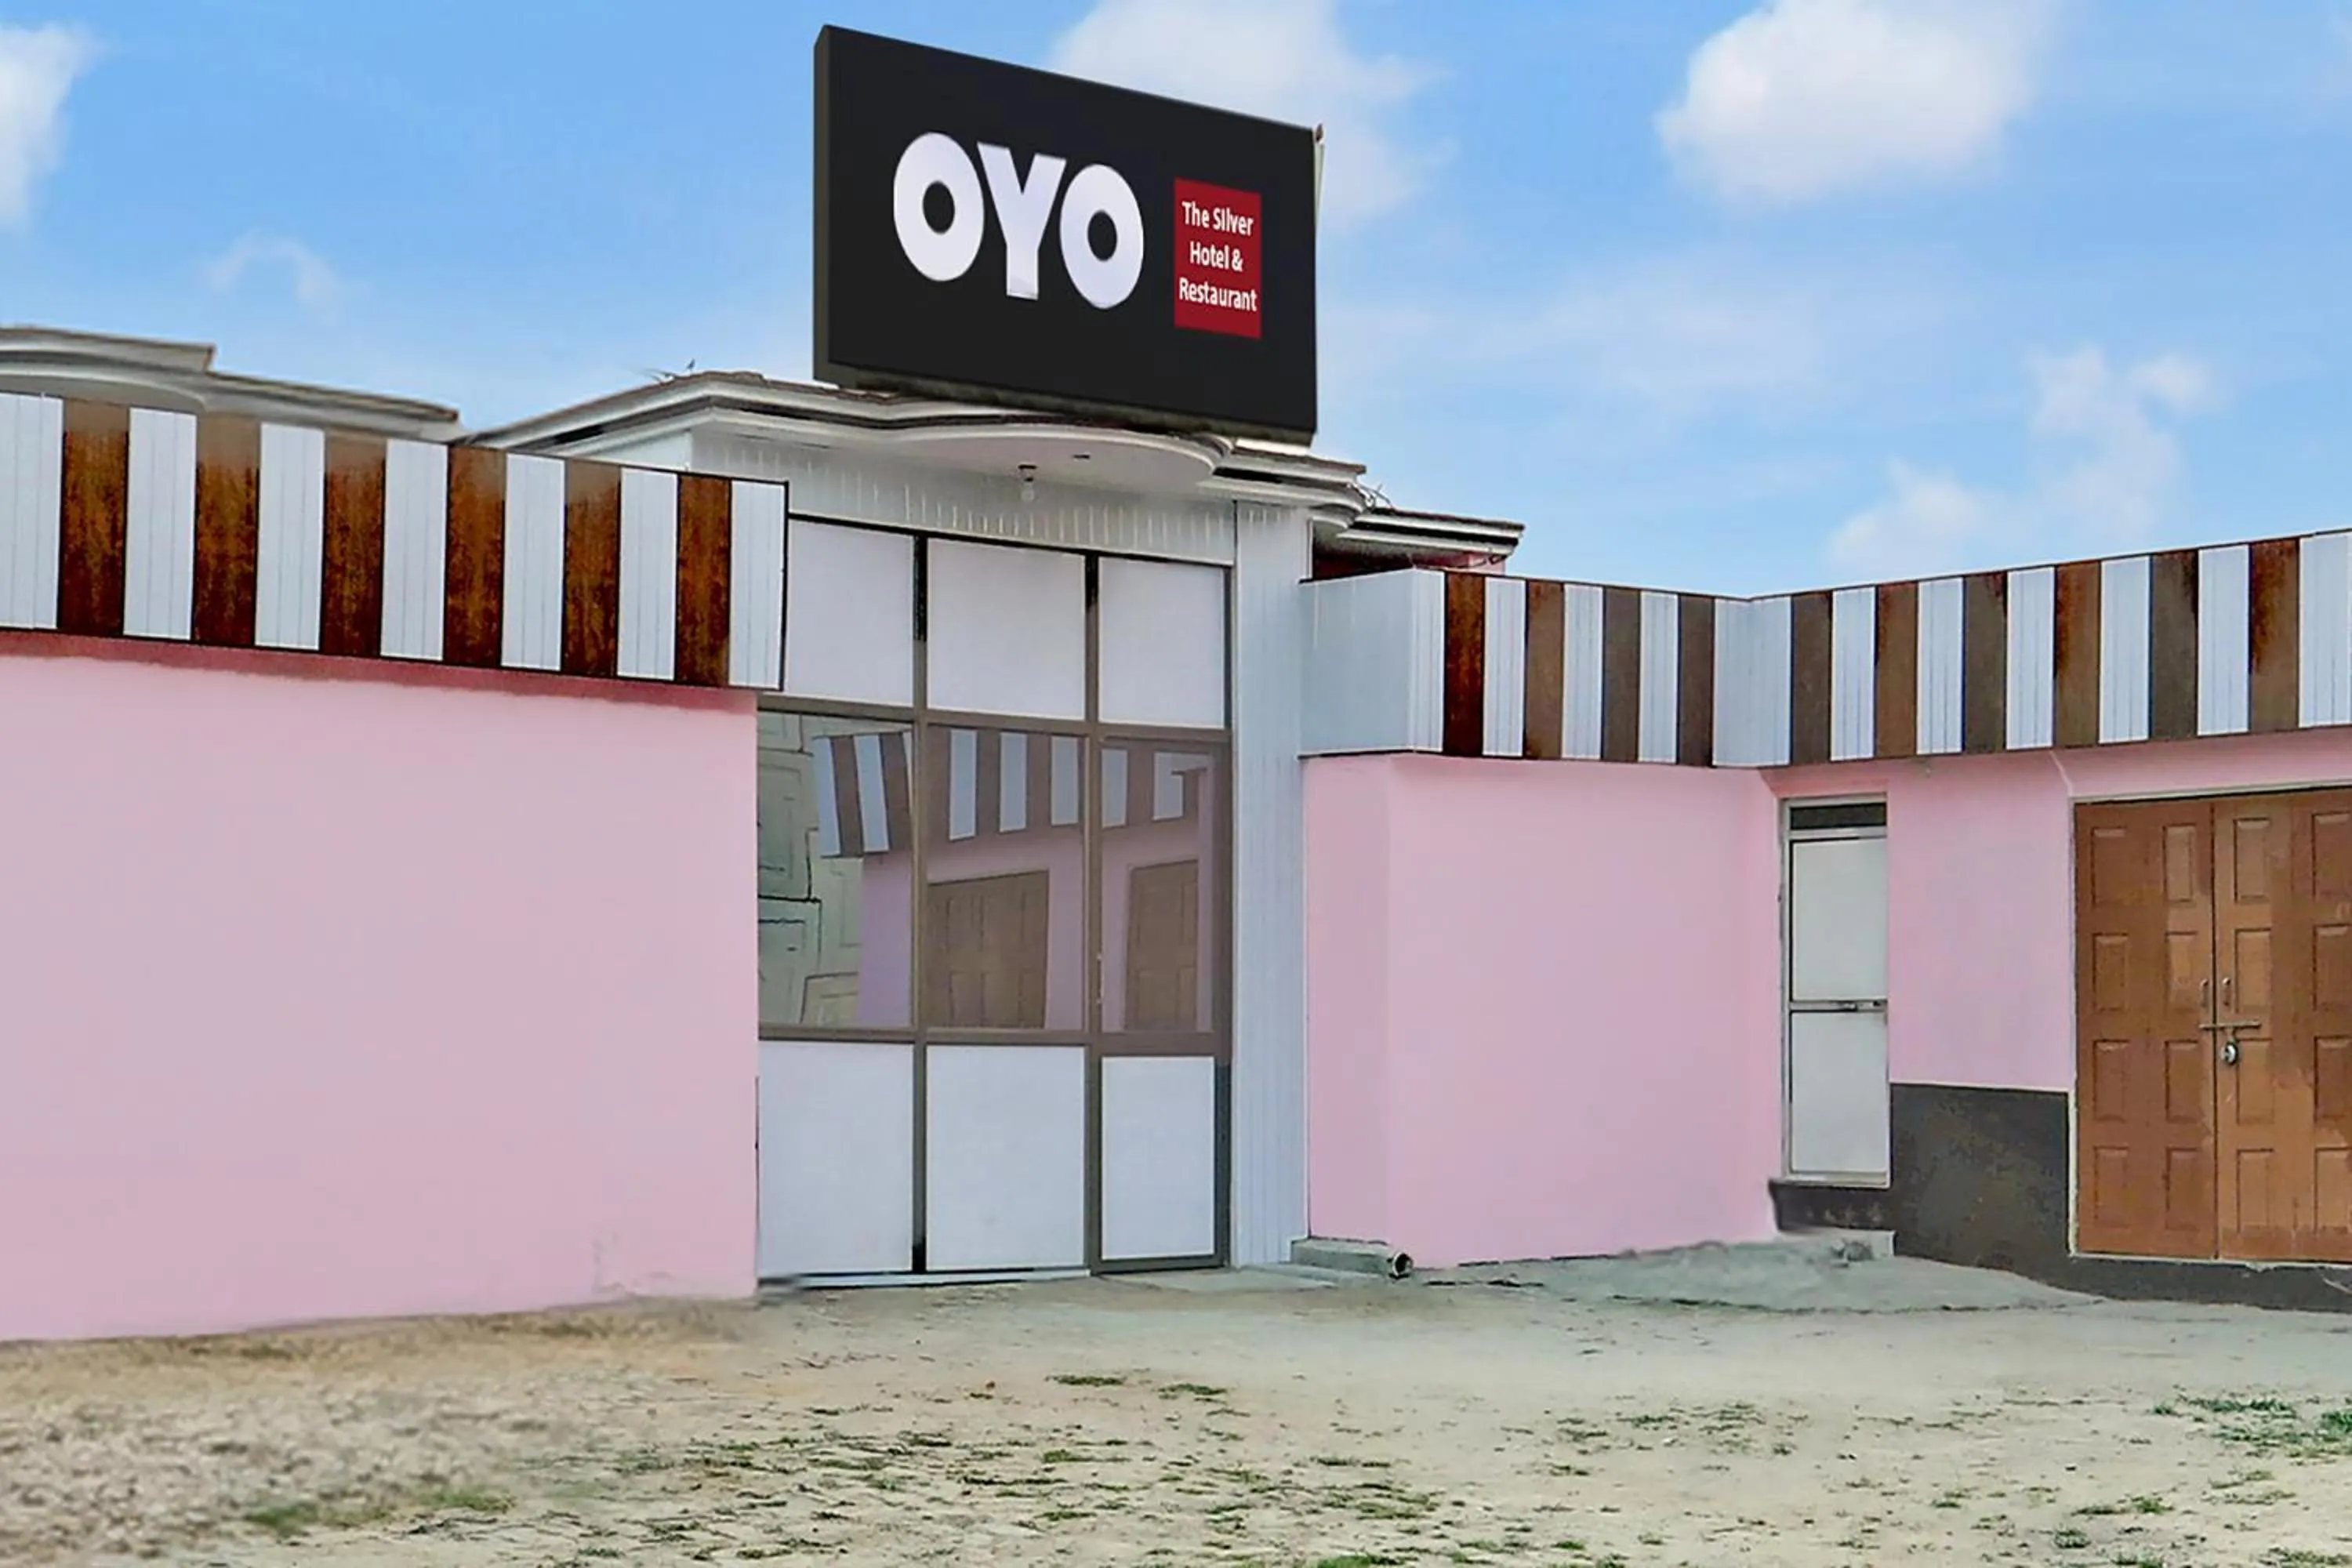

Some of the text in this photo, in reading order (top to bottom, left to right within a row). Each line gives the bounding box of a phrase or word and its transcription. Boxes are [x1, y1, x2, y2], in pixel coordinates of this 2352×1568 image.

[892, 132, 1145, 310] OYO
[1181, 201, 1254, 236] The Silver
[1189, 241, 1243, 272] Hotel &
[1178, 276, 1258, 312] Restaurant
